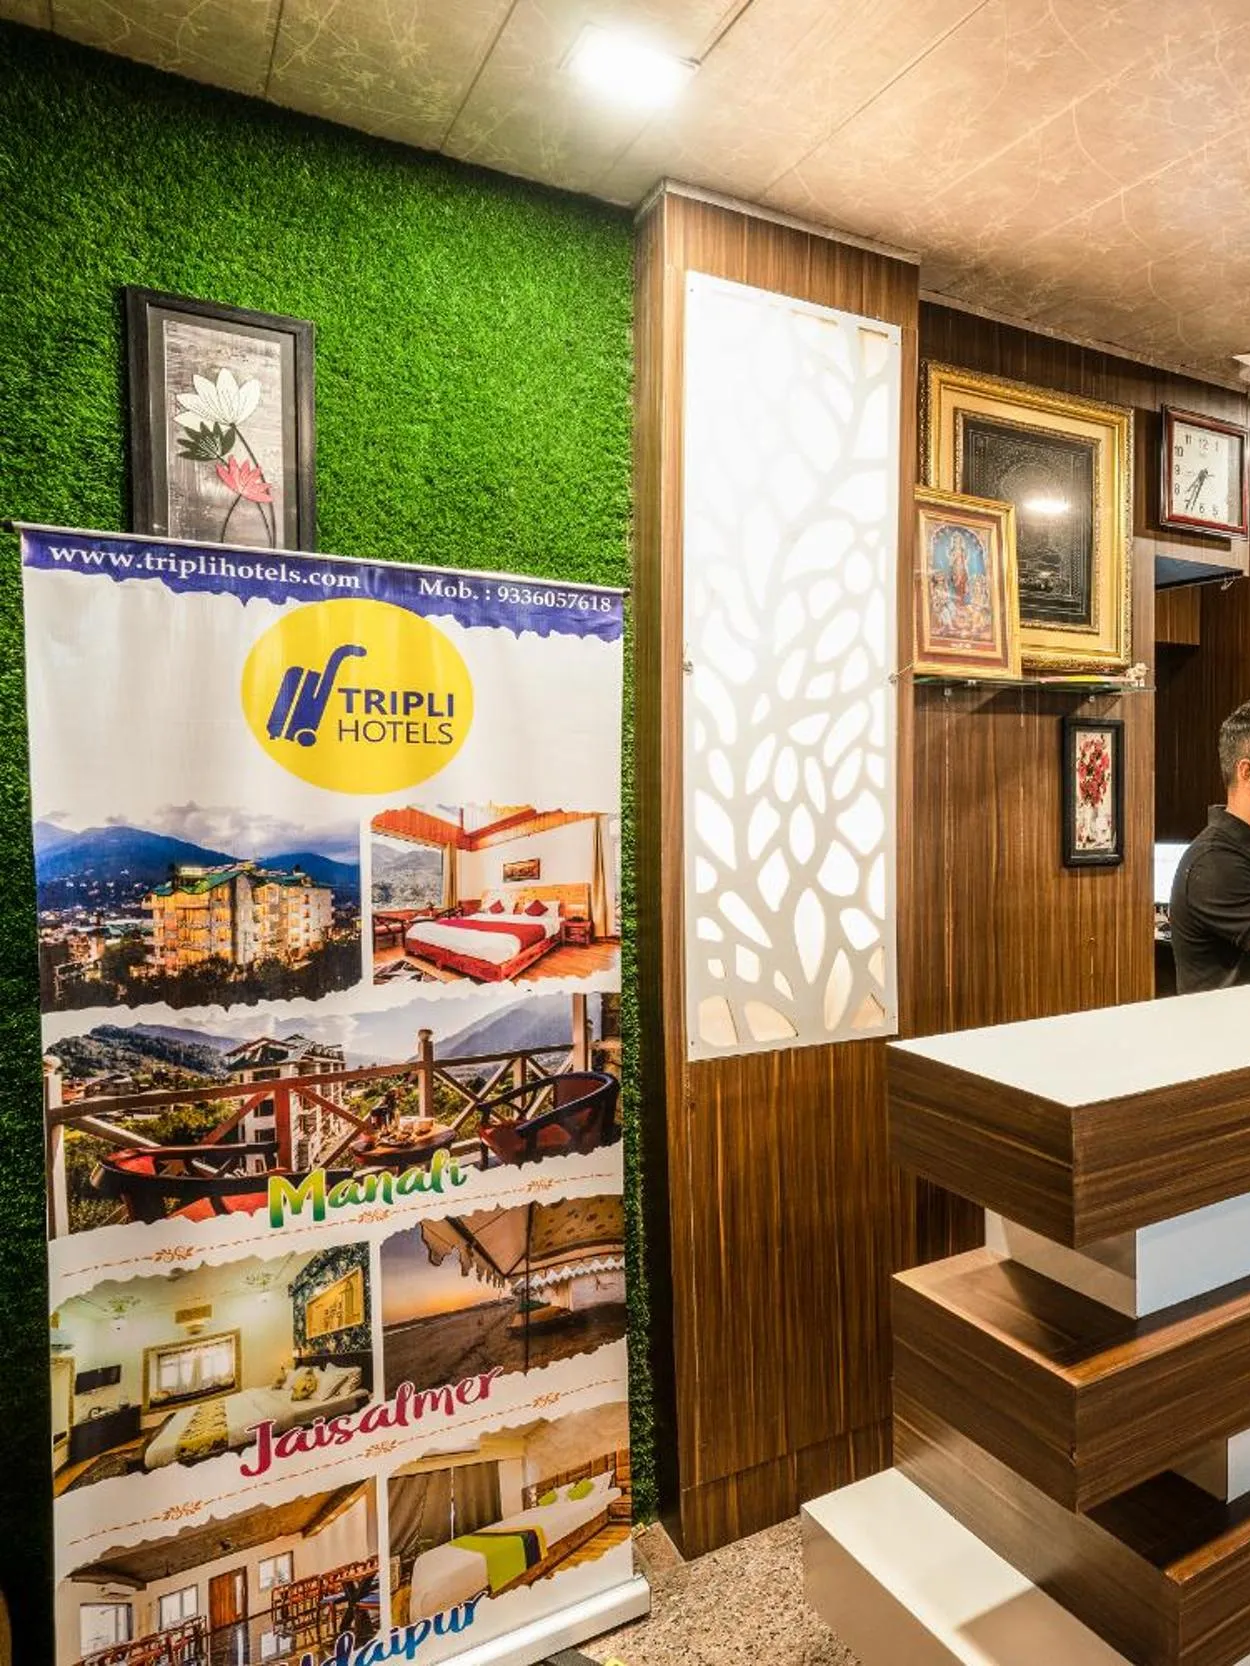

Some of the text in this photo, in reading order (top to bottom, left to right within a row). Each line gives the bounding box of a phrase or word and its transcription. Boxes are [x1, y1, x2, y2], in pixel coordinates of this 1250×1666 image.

[49, 545, 361, 590] www.triplihotels.com
[418, 577, 478, 600] Mob.
[498, 586, 612, 612] 9336057618
[337, 687, 454, 717] TRIPLI
[338, 719, 454, 744] HOTELS
[269, 1148, 467, 1228] Manali
[239, 1367, 504, 1479] Jaisalmer
